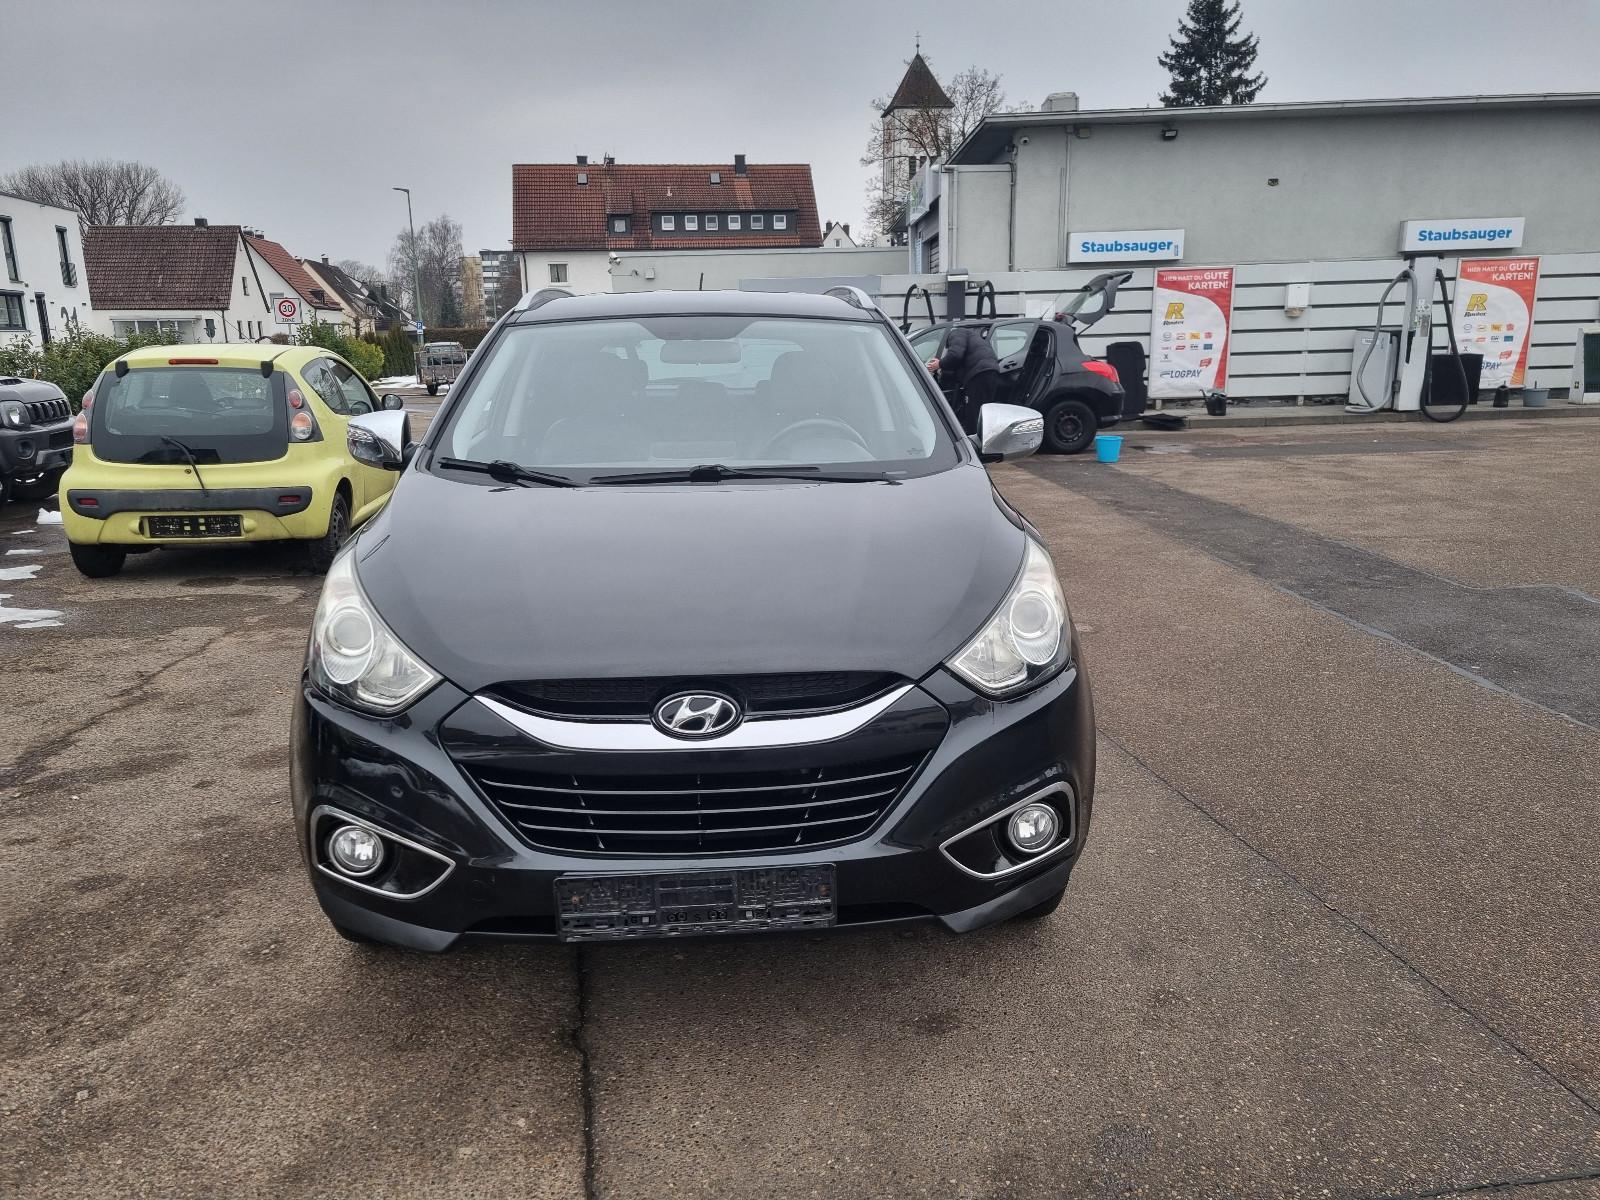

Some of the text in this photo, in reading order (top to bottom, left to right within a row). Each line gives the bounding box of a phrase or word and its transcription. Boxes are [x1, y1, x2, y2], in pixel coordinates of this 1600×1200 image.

[1418, 228, 1513, 242] Staubsauger
[1081, 240, 1173, 253] Staubsauger
[1509, 262, 1535, 271] GUTE
[1204, 271, 1229, 280] GUTE
[1492, 272, 1534, 281] KARTEN!
[1188, 281, 1229, 290] KARTEN!
[1466, 293, 1488, 311] R
[282, 304, 293, 312] 30
[1165, 302, 1185, 320] R
[1170, 369, 1202, 378] LOGPAY
